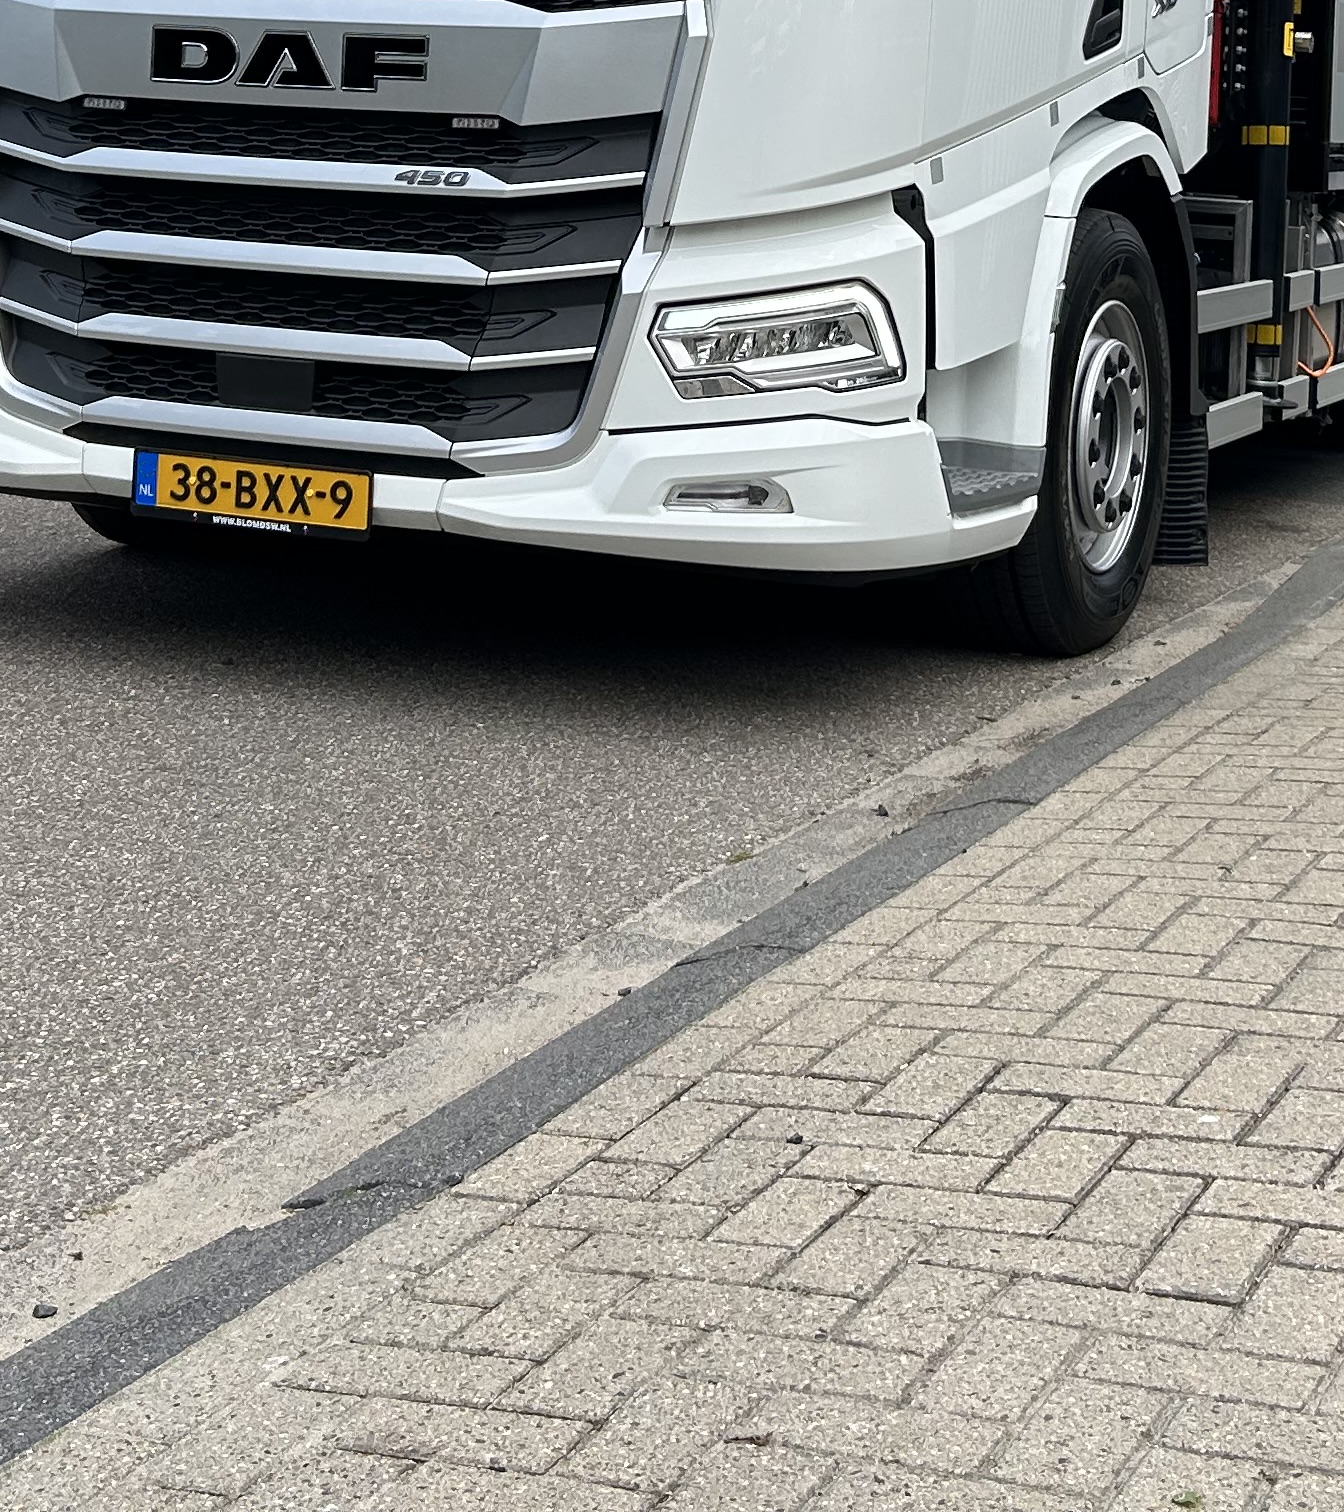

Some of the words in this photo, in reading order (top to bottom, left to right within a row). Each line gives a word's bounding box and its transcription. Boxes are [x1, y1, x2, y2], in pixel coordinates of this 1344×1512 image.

[150, 24, 430, 92] DAF
[394, 169, 471, 186] 450
[138, 483, 154, 497] NL
[169, 462, 354, 519] 38-BXX-9
